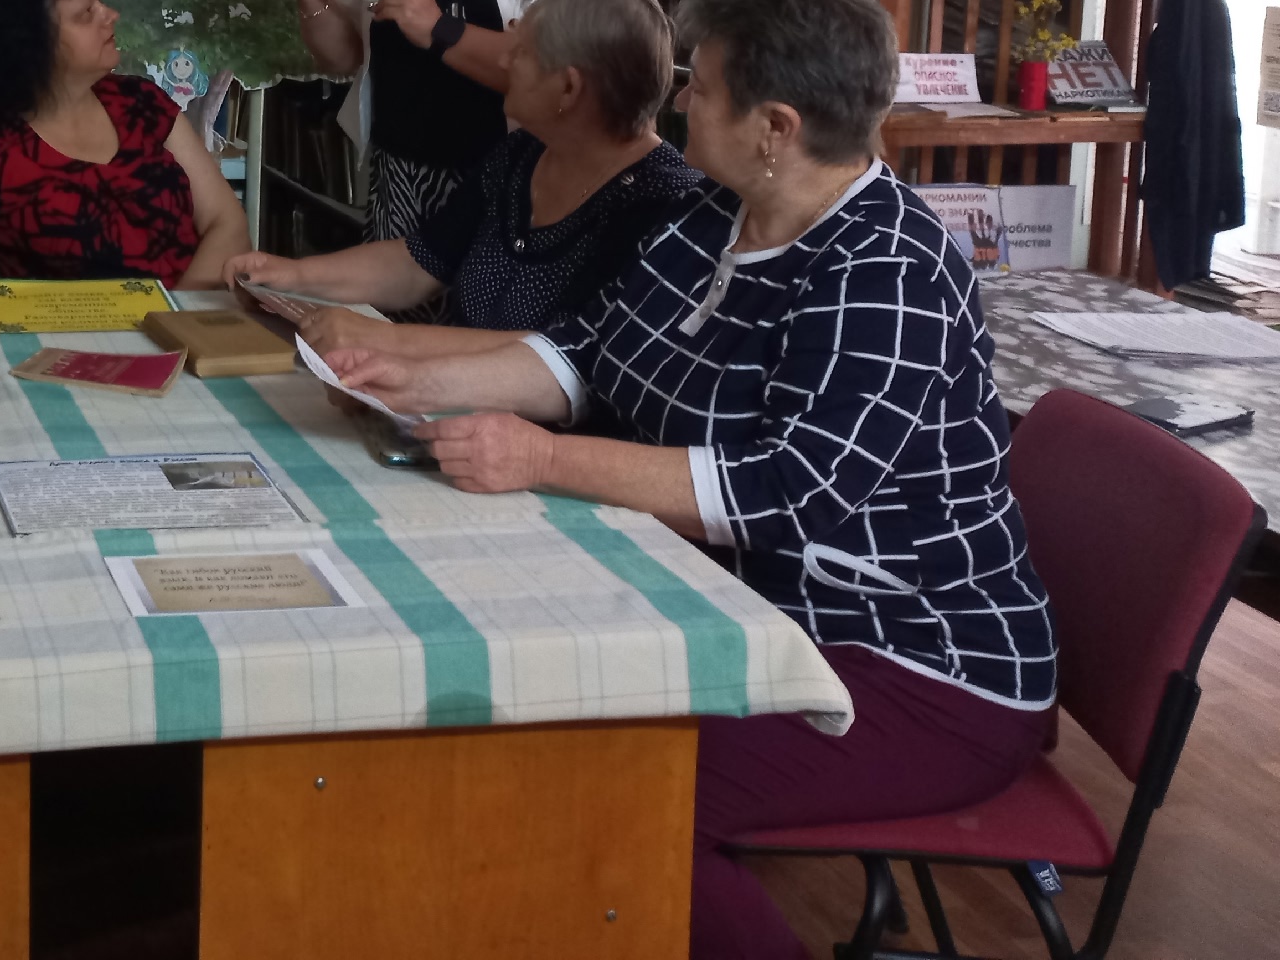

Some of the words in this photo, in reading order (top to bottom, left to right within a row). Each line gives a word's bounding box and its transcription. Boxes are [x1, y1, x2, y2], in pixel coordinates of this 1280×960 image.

[1047, 61, 1120, 90] НЕТ
[916, 84, 969, 96] УВЛЕЧЕНИЕ
[920, 193, 987, 204] АРКОМАНИИ
[1004, 223, 1053, 234] роблема
